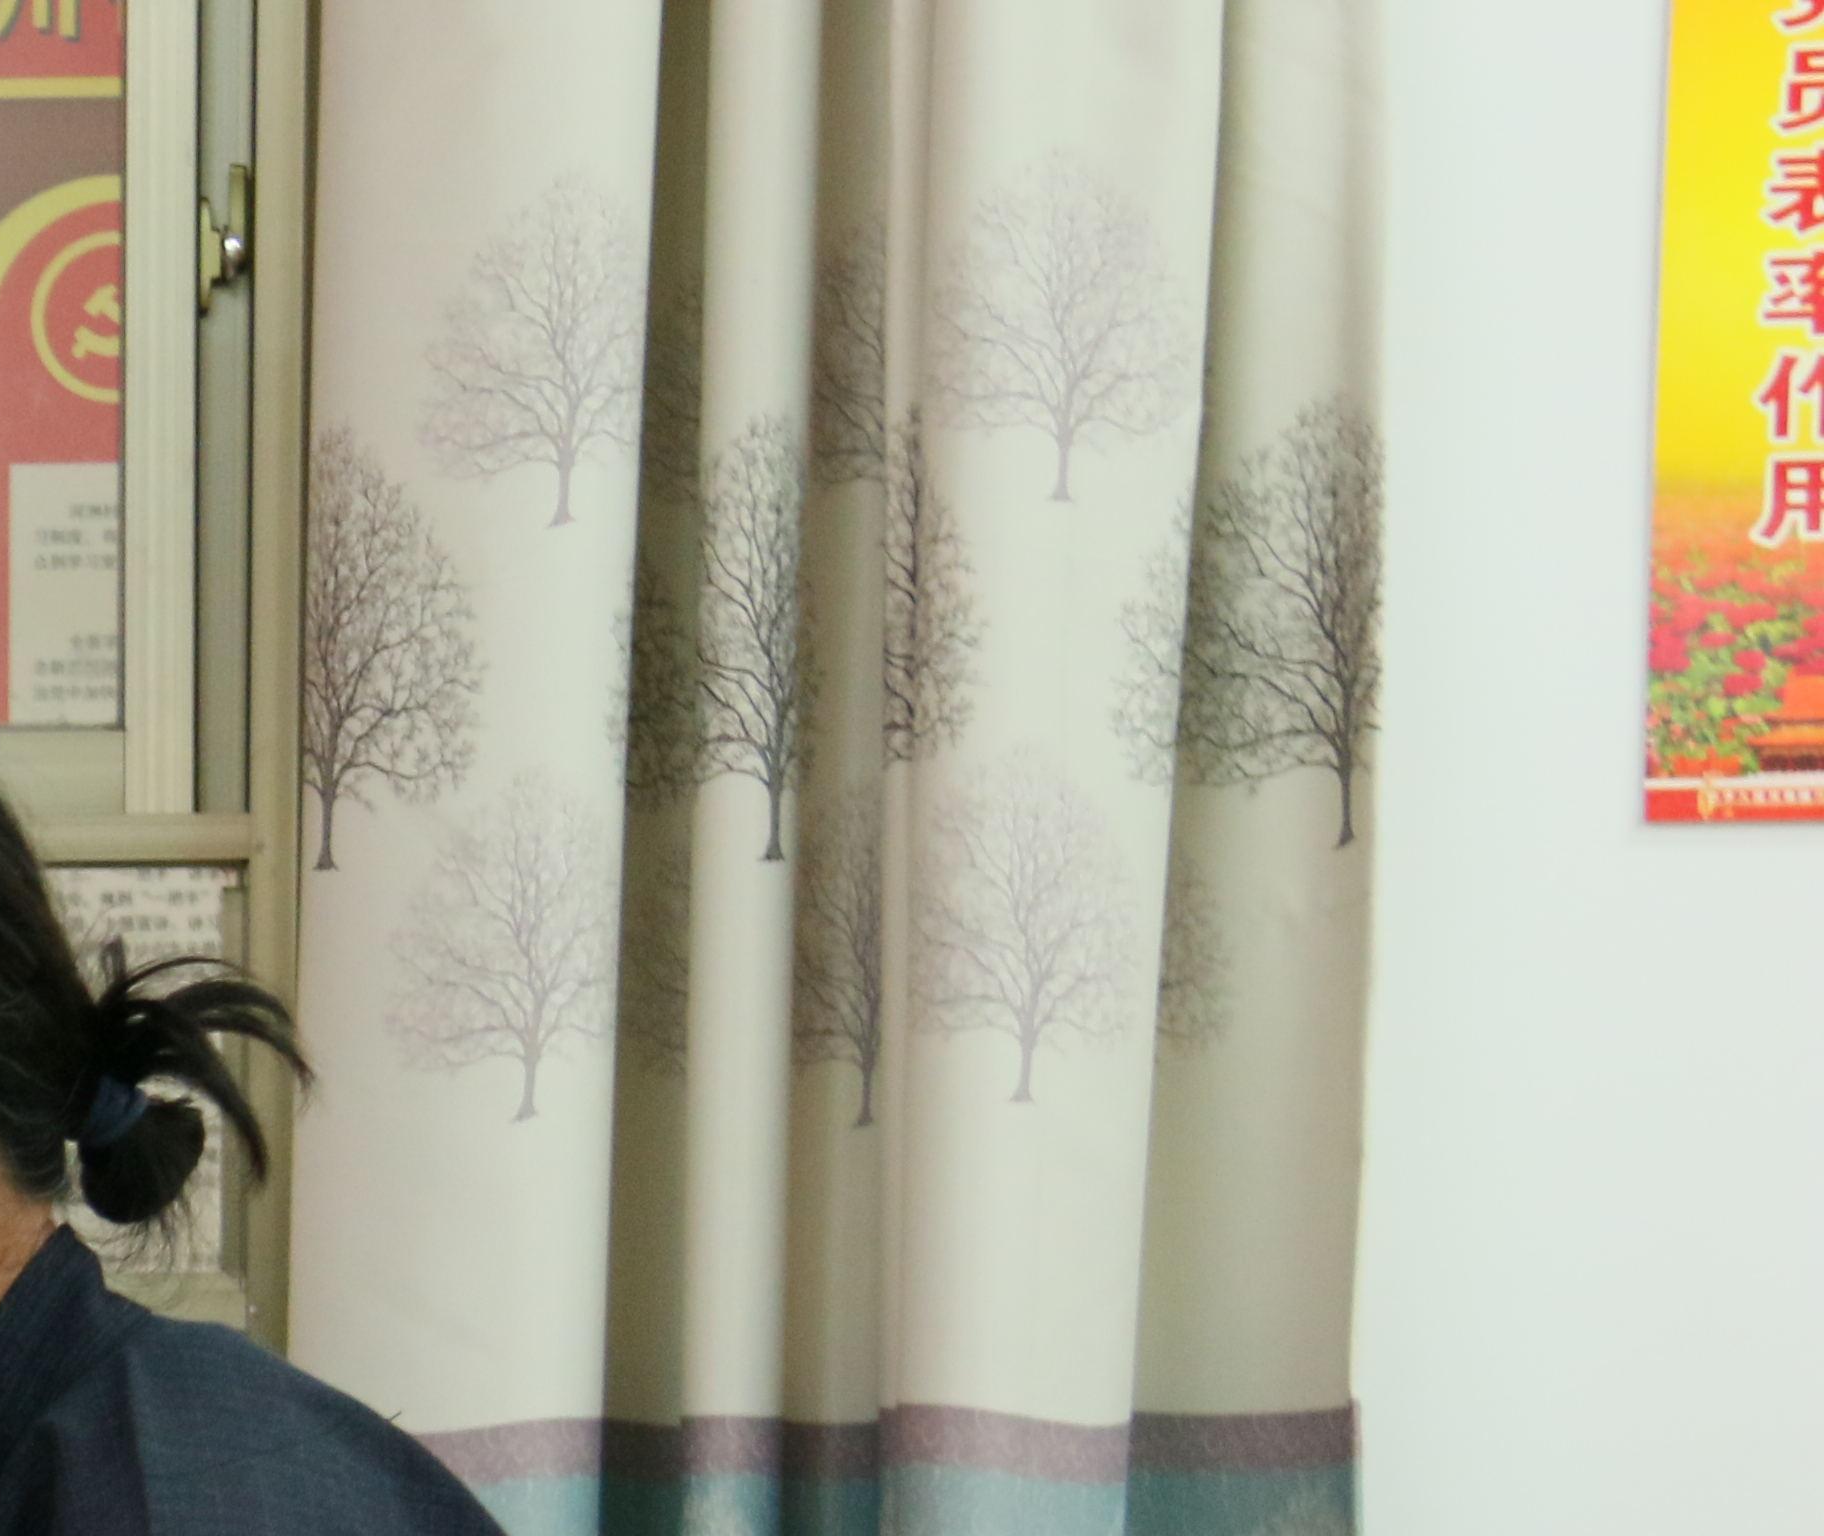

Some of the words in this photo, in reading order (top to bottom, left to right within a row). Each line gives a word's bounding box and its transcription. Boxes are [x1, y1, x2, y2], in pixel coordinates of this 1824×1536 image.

[1759, 0, 1824, 539] 员表率作用
